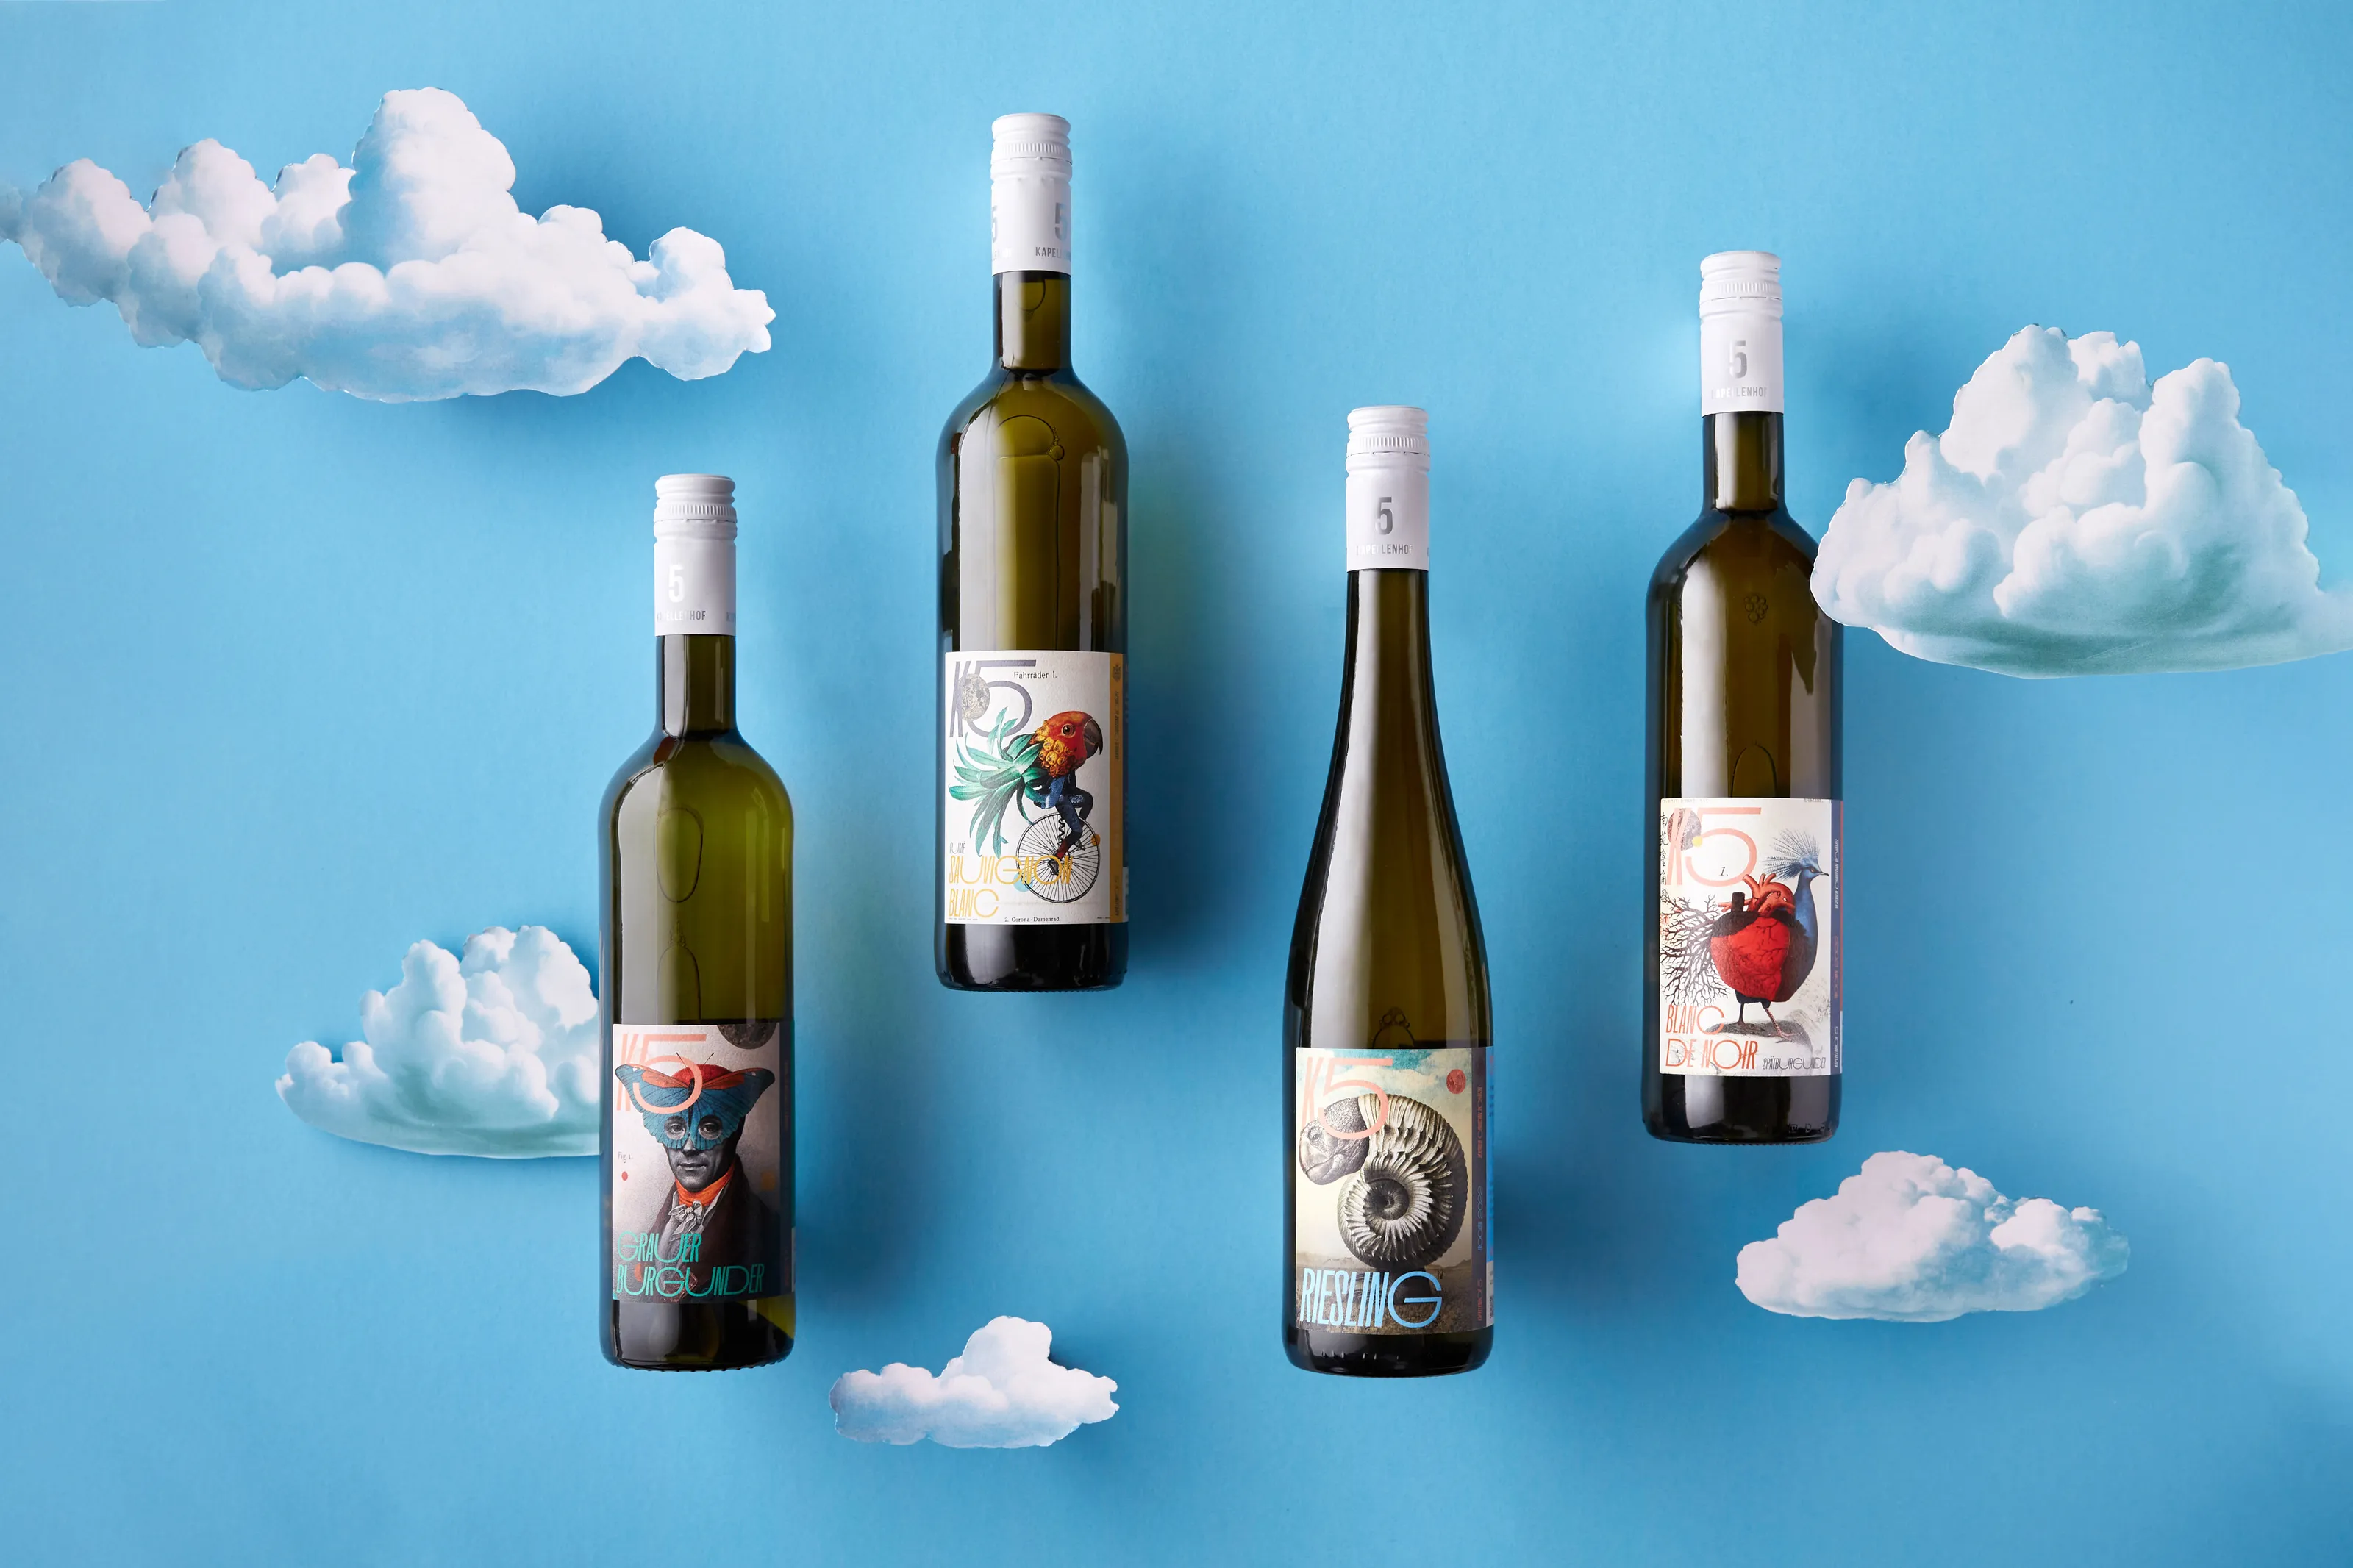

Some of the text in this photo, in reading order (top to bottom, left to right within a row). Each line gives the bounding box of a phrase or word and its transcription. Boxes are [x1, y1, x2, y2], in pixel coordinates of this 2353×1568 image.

[1729, 340, 1748, 379] 5
[1375, 496, 1393, 535] 5
[668, 564, 685, 603] 5
[1666, 806, 1762, 887] K5
[949, 855, 1073, 885] SAUVIGNON
[1718, 866, 1729, 876] 1.
[949, 889, 999, 918] BLANC
[1665, 1004, 1724, 1035] BLANC
[1665, 1038, 1758, 1070] DE NOIR
[1763, 1056, 1827, 1070] SPÄTBURGUNDER
[616, 1034, 707, 1114] K5
[1302, 1056, 1393, 1139] K5
[617, 1230, 702, 1263] GRAUER
[616, 1264, 765, 1297] BURGUNDER
[1300, 1267, 1443, 1328] RIESLING
